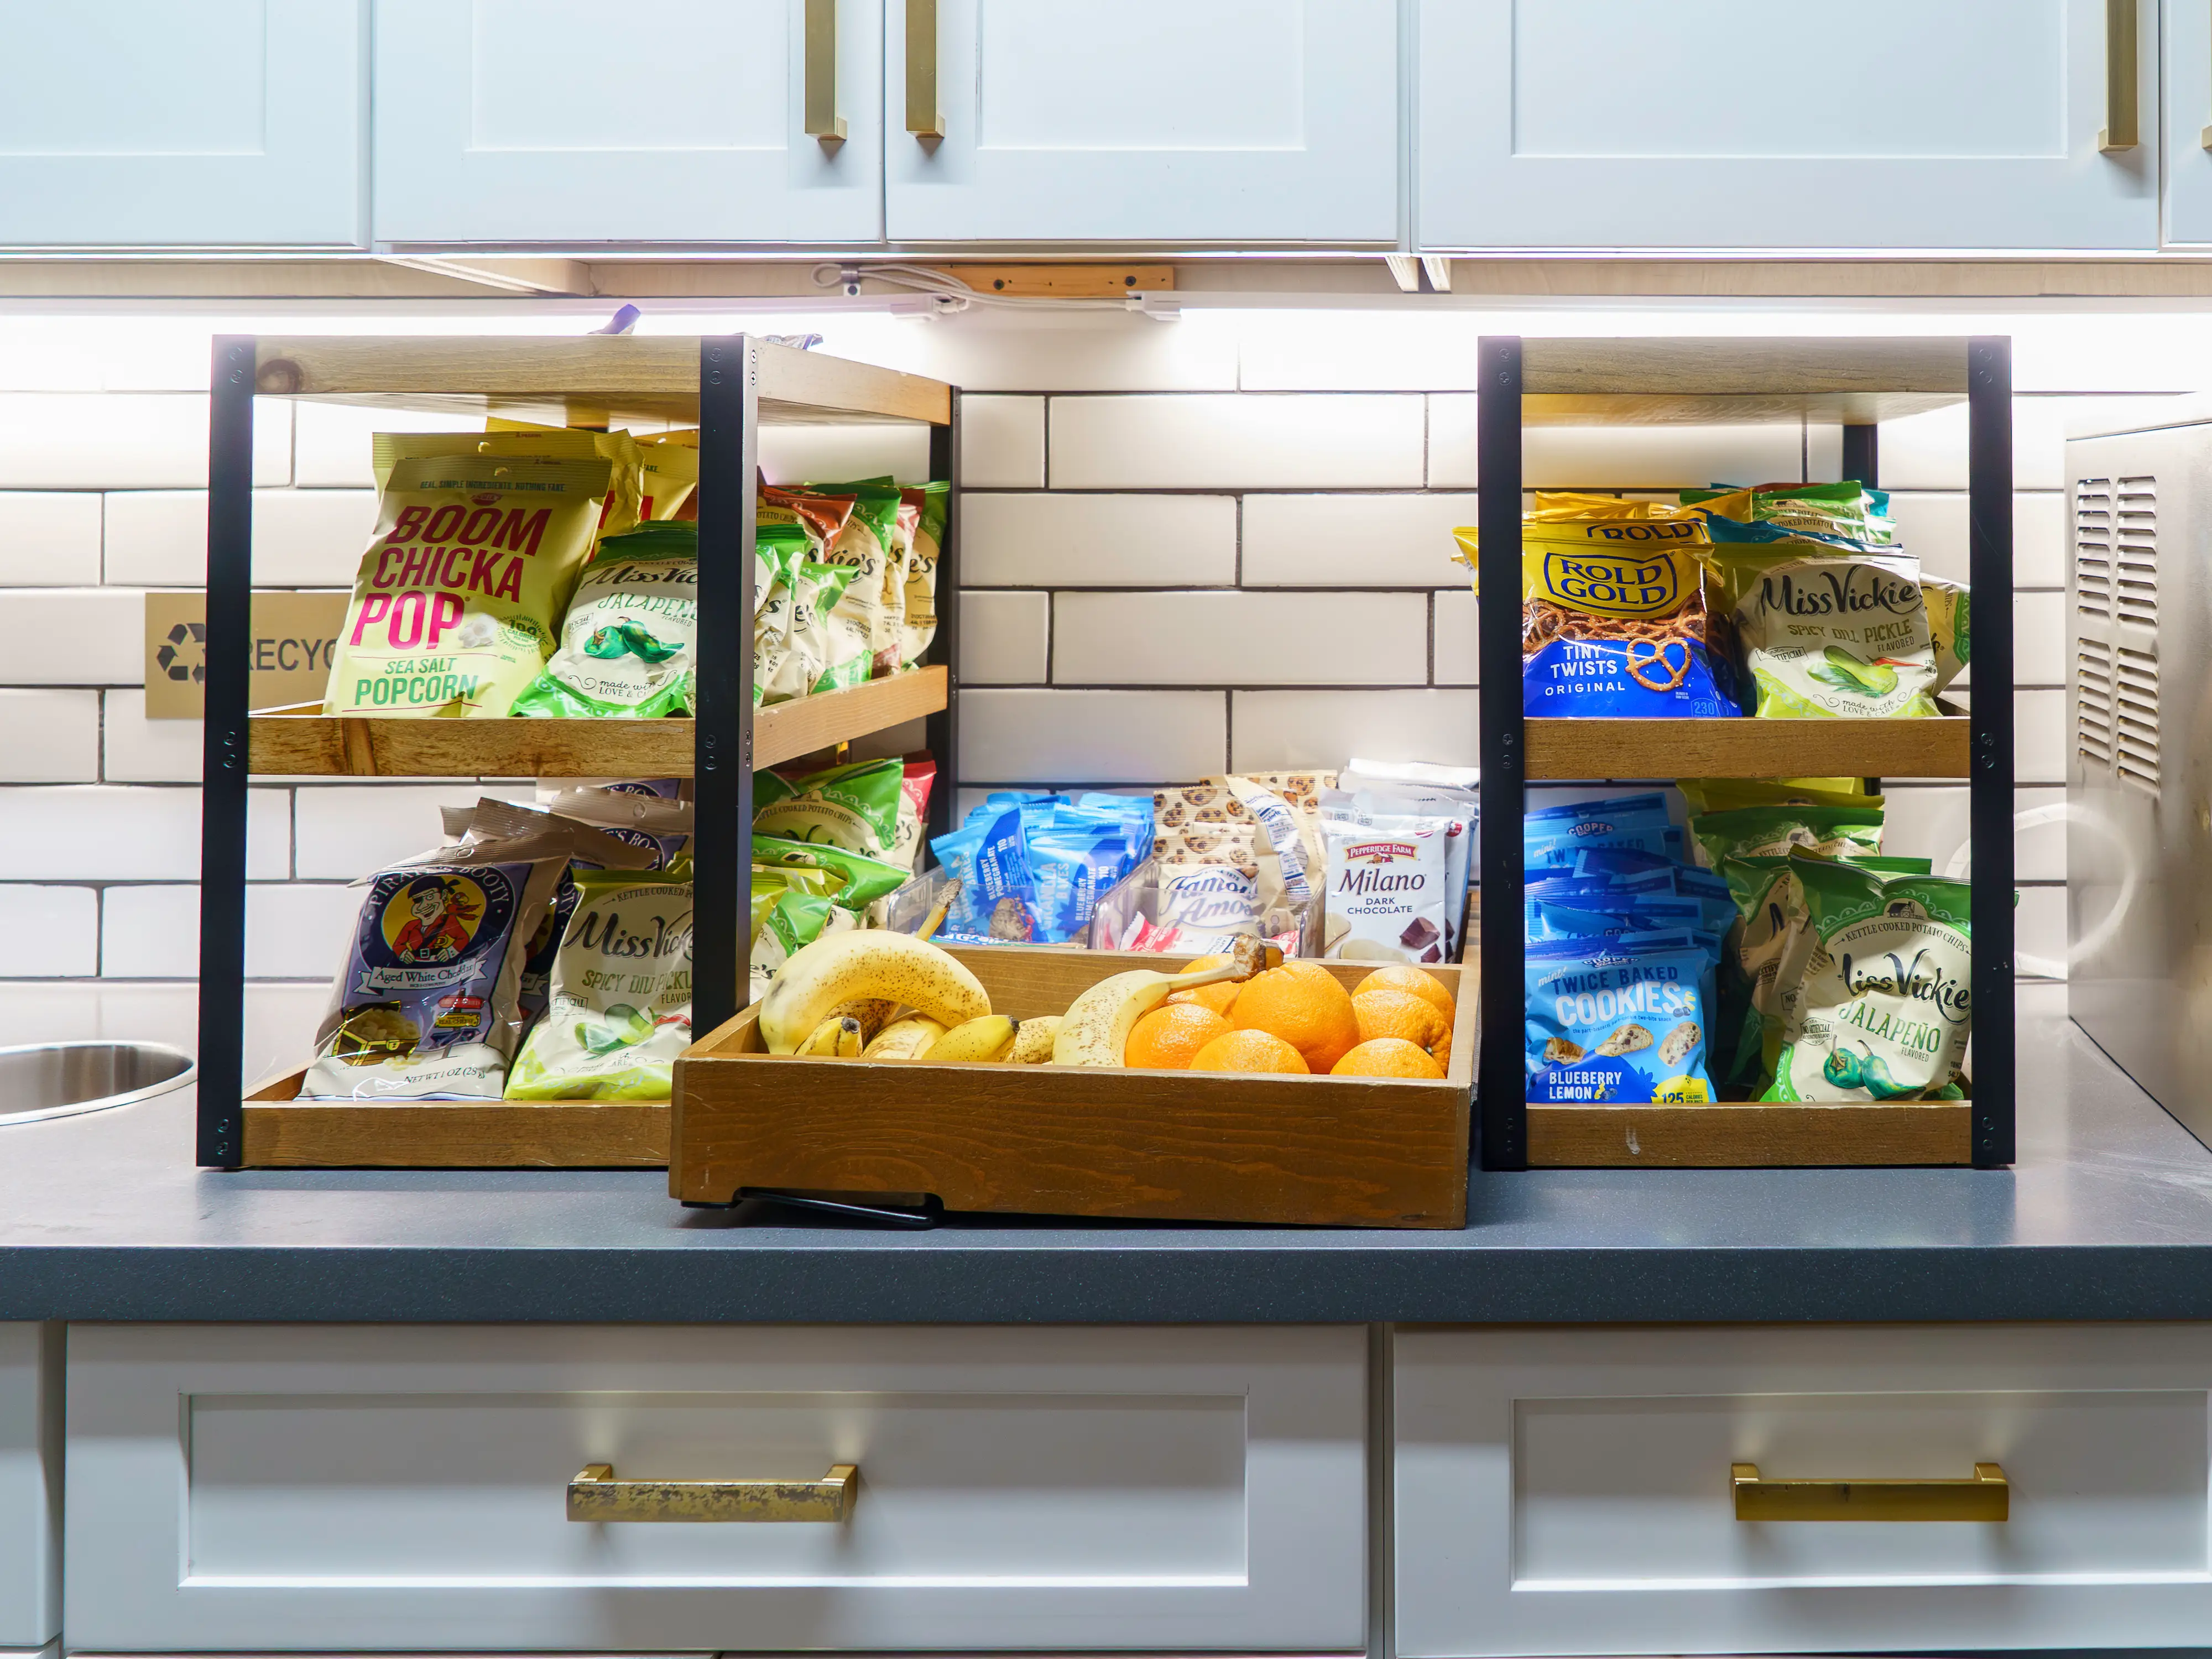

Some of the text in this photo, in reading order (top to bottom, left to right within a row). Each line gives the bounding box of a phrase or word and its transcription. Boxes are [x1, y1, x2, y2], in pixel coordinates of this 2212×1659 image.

[439, 481, 464, 489] SIMPLE
[514, 482, 546, 491] NOTHING
[384, 504, 553, 557] BOOM
[371, 547, 525, 603] CHICKA
[581, 566, 664, 589] Miss
[1560, 559, 1662, 585] ROLD
[1561, 578, 1667, 604] GOLD
[1761, 575, 1833, 616] Miss
[349, 590, 466, 650] POP
[509, 619, 538, 636] 100
[661, 615, 693, 627] FLAVORED
[1787, 618, 1912, 643] SPICY DILL PICKLE
[1563, 644, 1602, 660] TINY
[1877, 636, 1915, 653] FLAVORED
[385, 657, 457, 675] SEA SALT
[1550, 660, 1618, 679] TWISTS
[354, 674, 478, 706] POPCORN
[599, 680, 630, 689] made
[599, 687, 624, 697] LOVE
[1545, 681, 1626, 696] ORIGINAL
[1694, 701, 1715, 714] 230
[1843, 699, 1895, 712] made with
[1843, 706, 1864, 716] LOVE
[1875, 705, 1895, 717] CARE
[997, 838, 1008, 852] 110
[1350, 843, 1412, 857] PEPPERIDGE FARM
[980, 859, 996, 900] BLUEBERRY
[987, 846, 1005, 897] POMEGRANATE
[460, 867, 509, 903] BOOTY
[1338, 868, 1426, 896] Milano
[617, 886, 685, 902] KETTLE COOKED
[1347, 905, 1413, 914] CHOCOLATE
[563, 911, 653, 959] Miss
[1845, 922, 1969, 952] KETTLE COOKED POTATO CHIPS
[374, 971, 403, 984] Aged
[405, 971, 435, 983] White
[582, 969, 626, 992] SPICY
[1538, 966, 1568, 987] mini!
[1551, 967, 1678, 995] TWICE BAKED
[1556, 981, 1681, 1027] COOKIES
[1839, 999, 1942, 1053] JALAPEÑO
[1901, 1047, 1929, 1062] FLAVORED
[404, 1074, 425, 1084] NET
[425, 1072, 441, 1081] WT
[447, 1068, 461, 1077] OZ
[1550, 1072, 1622, 1085] BLUEBERRY
[1550, 1086, 1592, 1100] LEMON
[1661, 1092, 1684, 1103] 125
